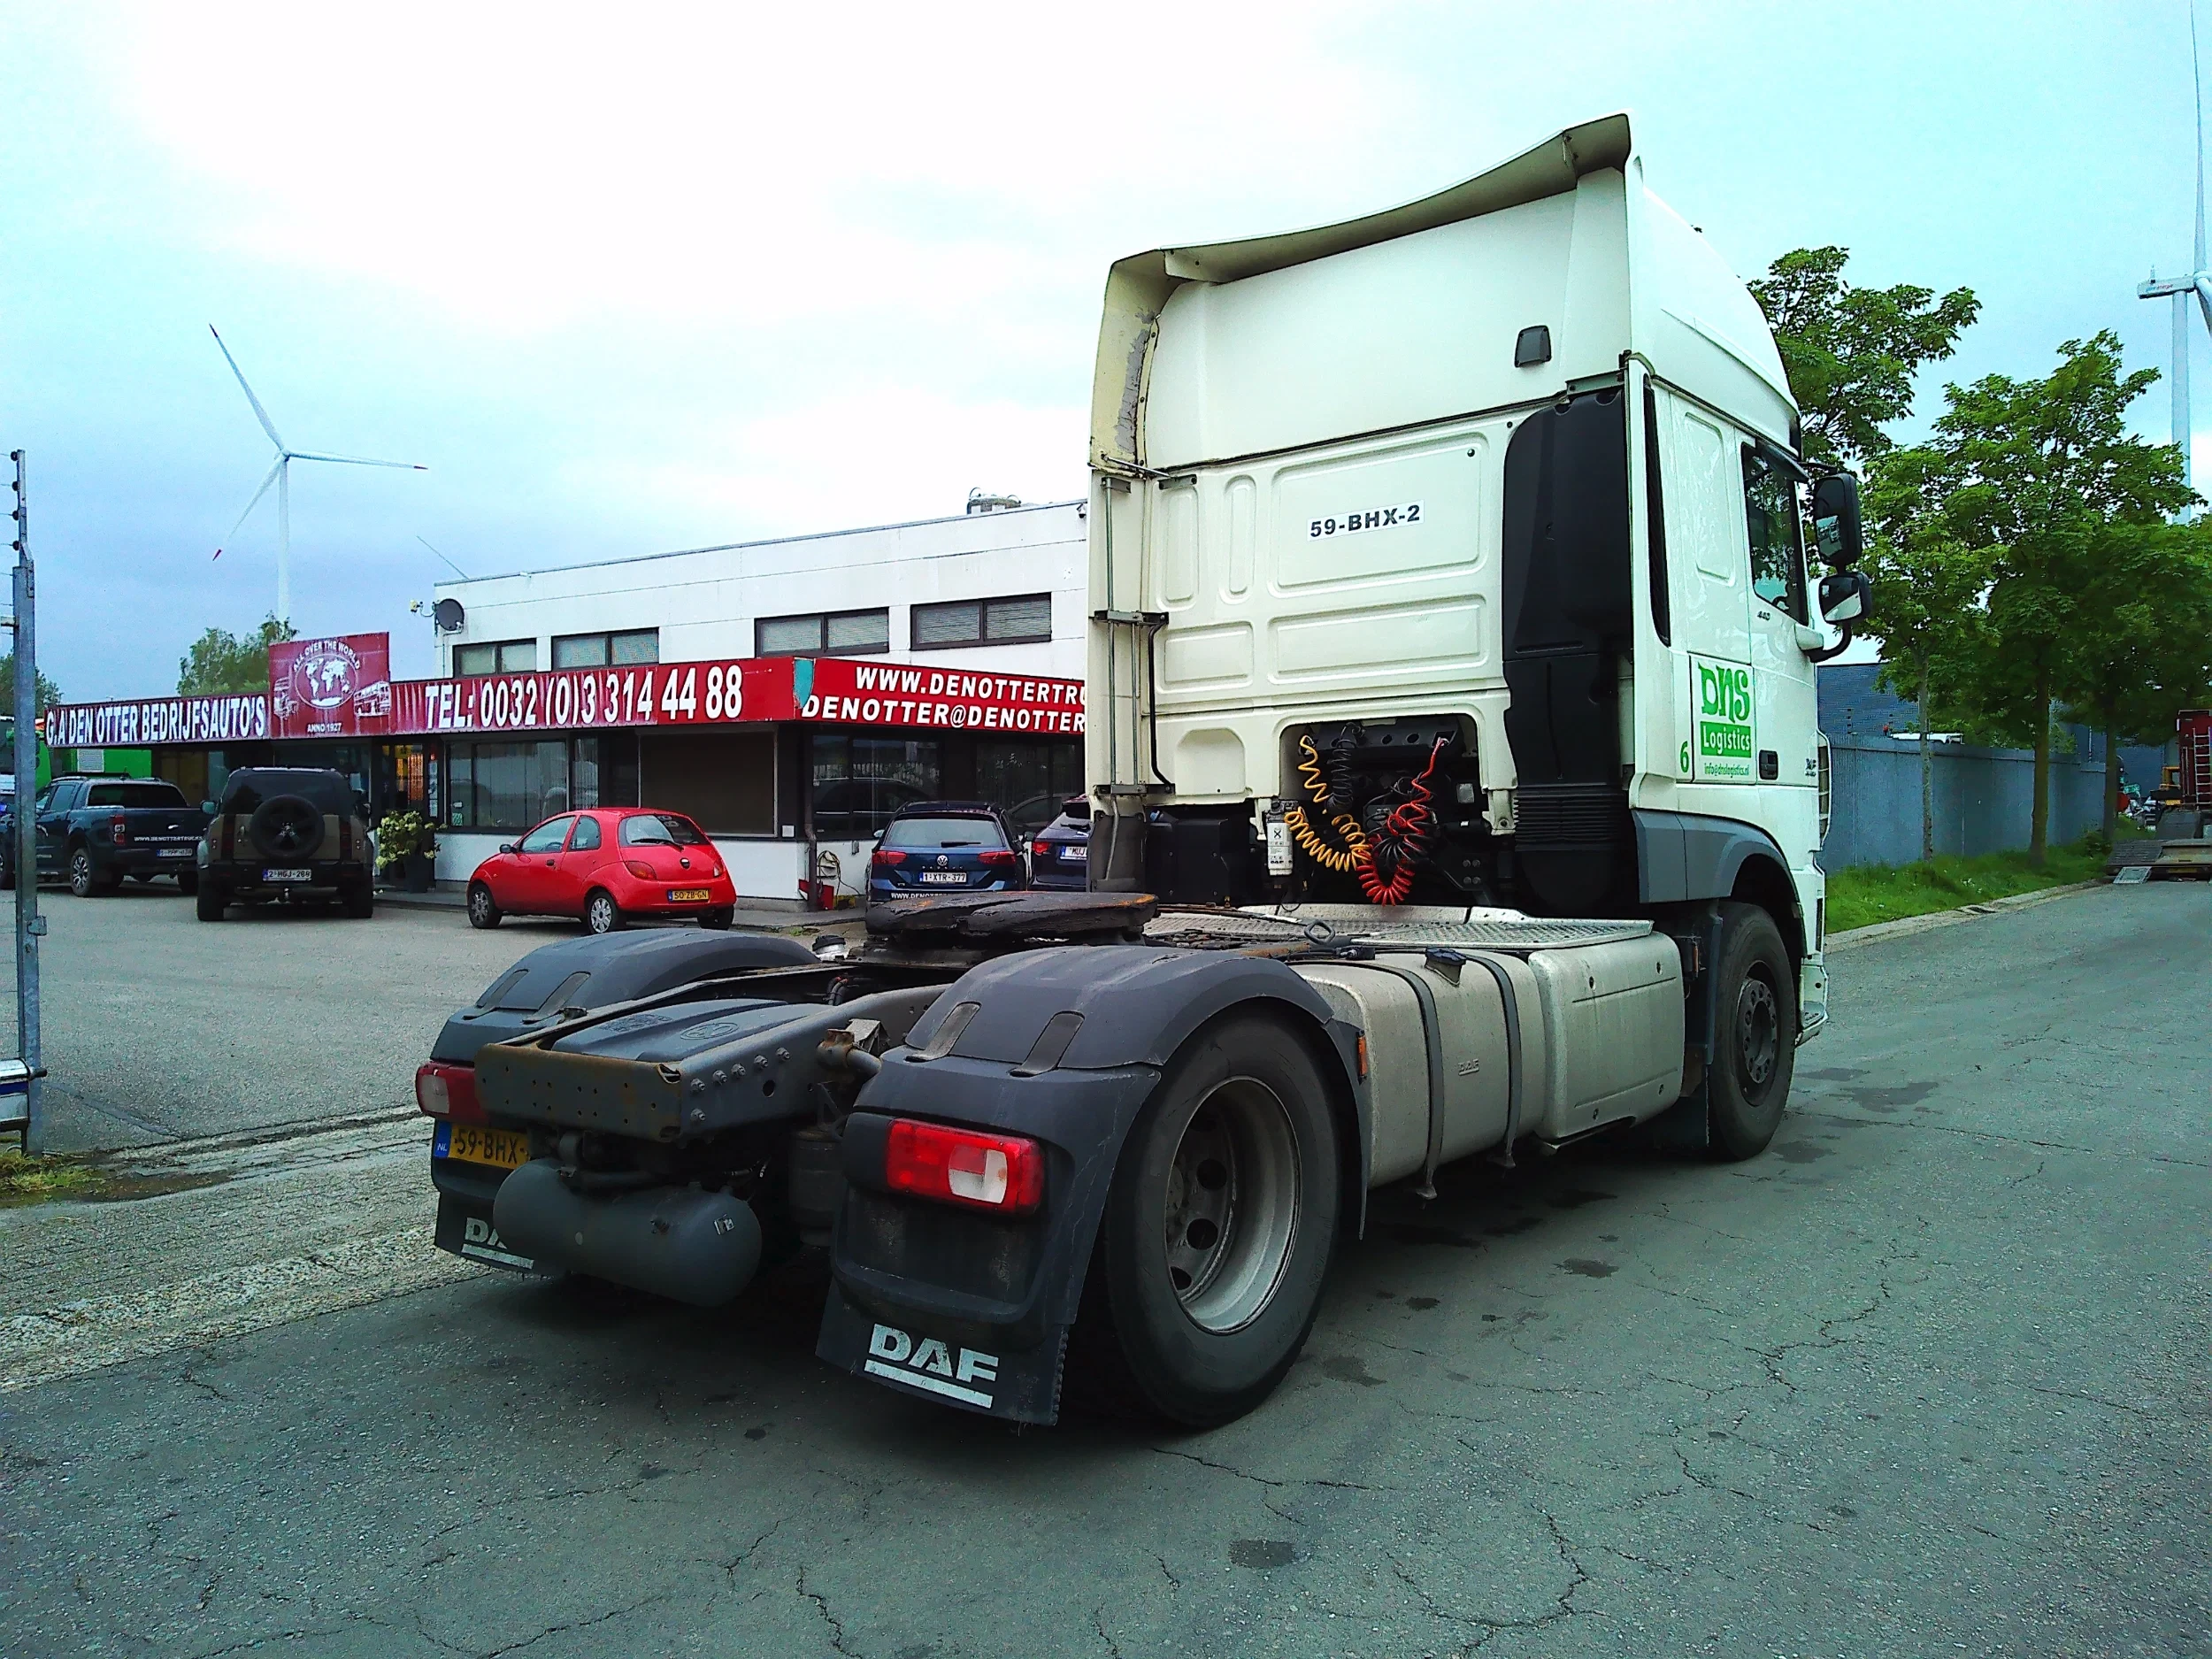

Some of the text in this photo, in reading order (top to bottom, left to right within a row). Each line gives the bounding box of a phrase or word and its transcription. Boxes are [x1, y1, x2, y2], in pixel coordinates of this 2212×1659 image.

[1310, 504, 1420, 538] 59-BHX-2
[293, 641, 360, 672] ALL OVER THE WORLD
[425, 683, 473, 730] TEL:
[480, 679, 537, 727] 0032
[605, 671, 653, 722] 314
[661, 668, 697, 721] 44
[706, 664, 743, 718] 88
[802, 695, 1085, 733] DENOTTER@DENOTTER
[68, 708, 94, 744] DEN
[96, 704, 138, 743] OTTER
[142, 695, 265, 741] BEDRIJFSAUTO'S
[307, 722, 342, 733] ANNO 1927
[1680, 741, 1690, 773] 6
[1703, 726, 1751, 755] Logistics
[457, 1128, 531, 1164] 59-BHX-
[869, 1323, 999, 1383] DAF
